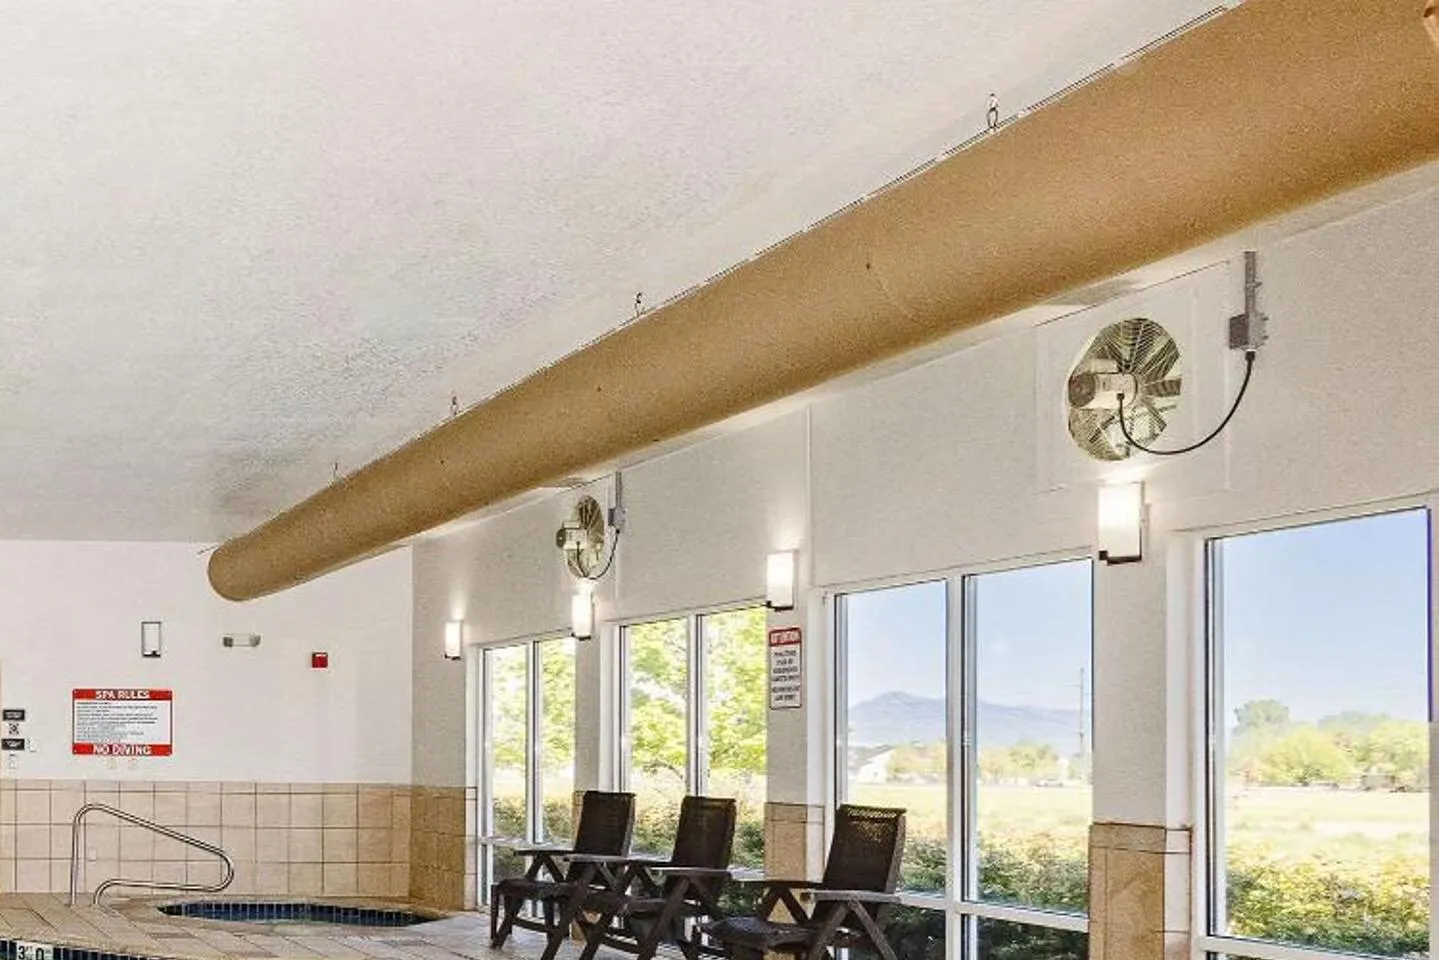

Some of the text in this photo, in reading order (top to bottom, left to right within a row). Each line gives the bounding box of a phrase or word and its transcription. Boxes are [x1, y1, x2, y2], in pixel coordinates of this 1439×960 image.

[95, 690, 149, 700] SPA RULES
[93, 743, 152, 756] NO DIVING
[18, 945, 25, 960] 3
